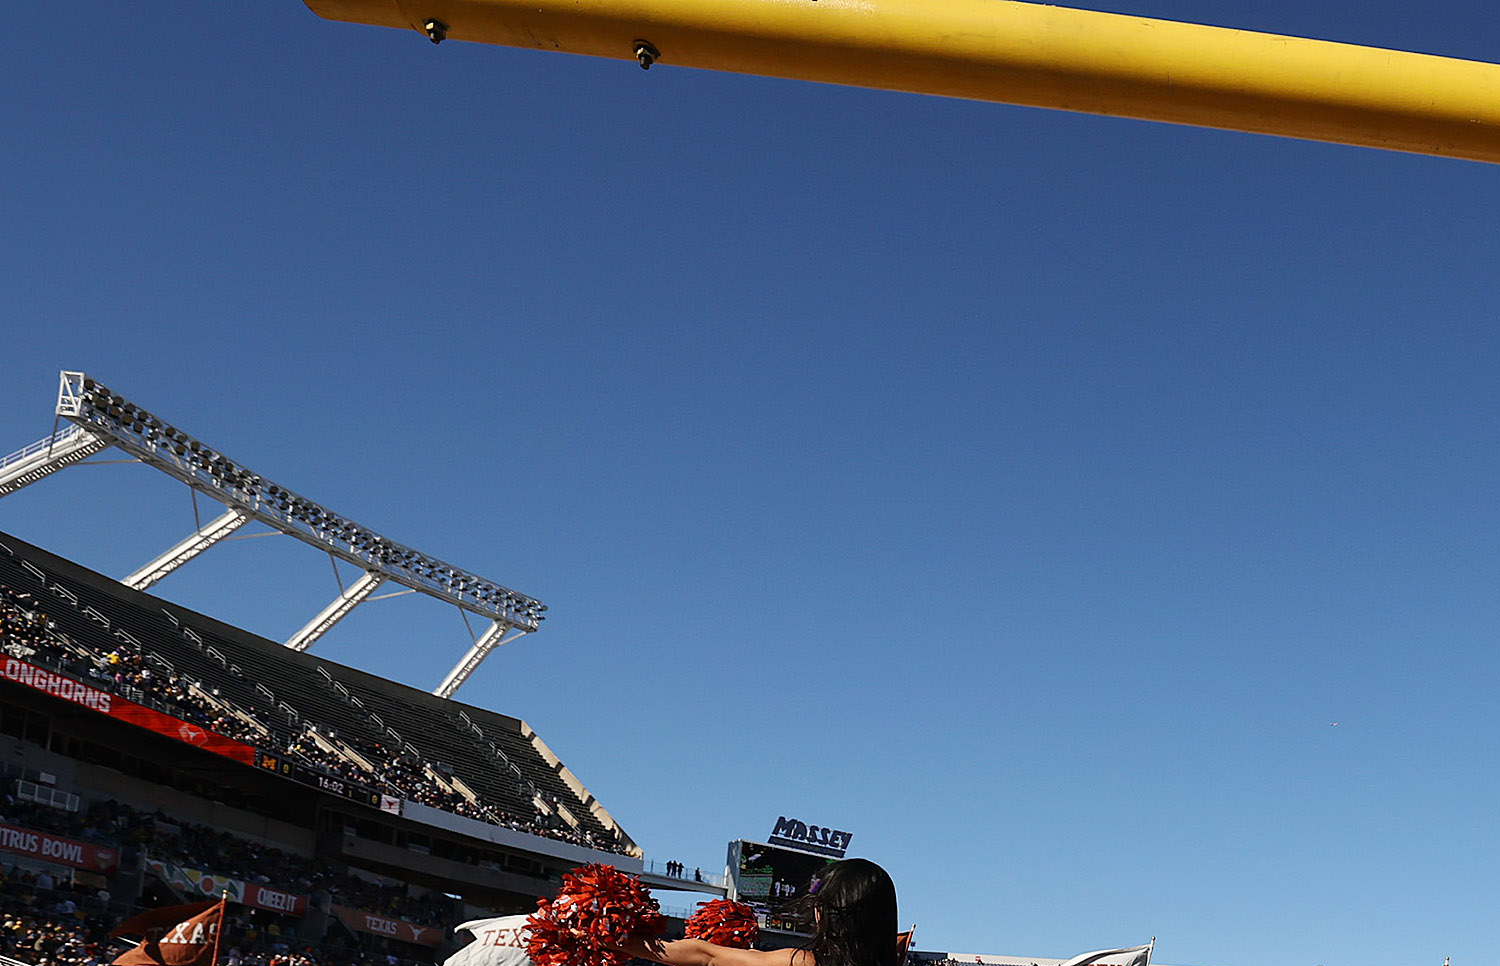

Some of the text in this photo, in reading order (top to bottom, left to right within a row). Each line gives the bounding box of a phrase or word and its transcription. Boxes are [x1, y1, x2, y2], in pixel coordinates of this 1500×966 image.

[0, 659, 111, 712] ONGHORNS
[319, 777, 344, 794] 16:02
[0, 828, 83, 863] TRUS BOWL
[773, 816, 853, 849] MASSEY
[365, 915, 397, 935] TEXAS
[482, 928, 527, 948] TEX
